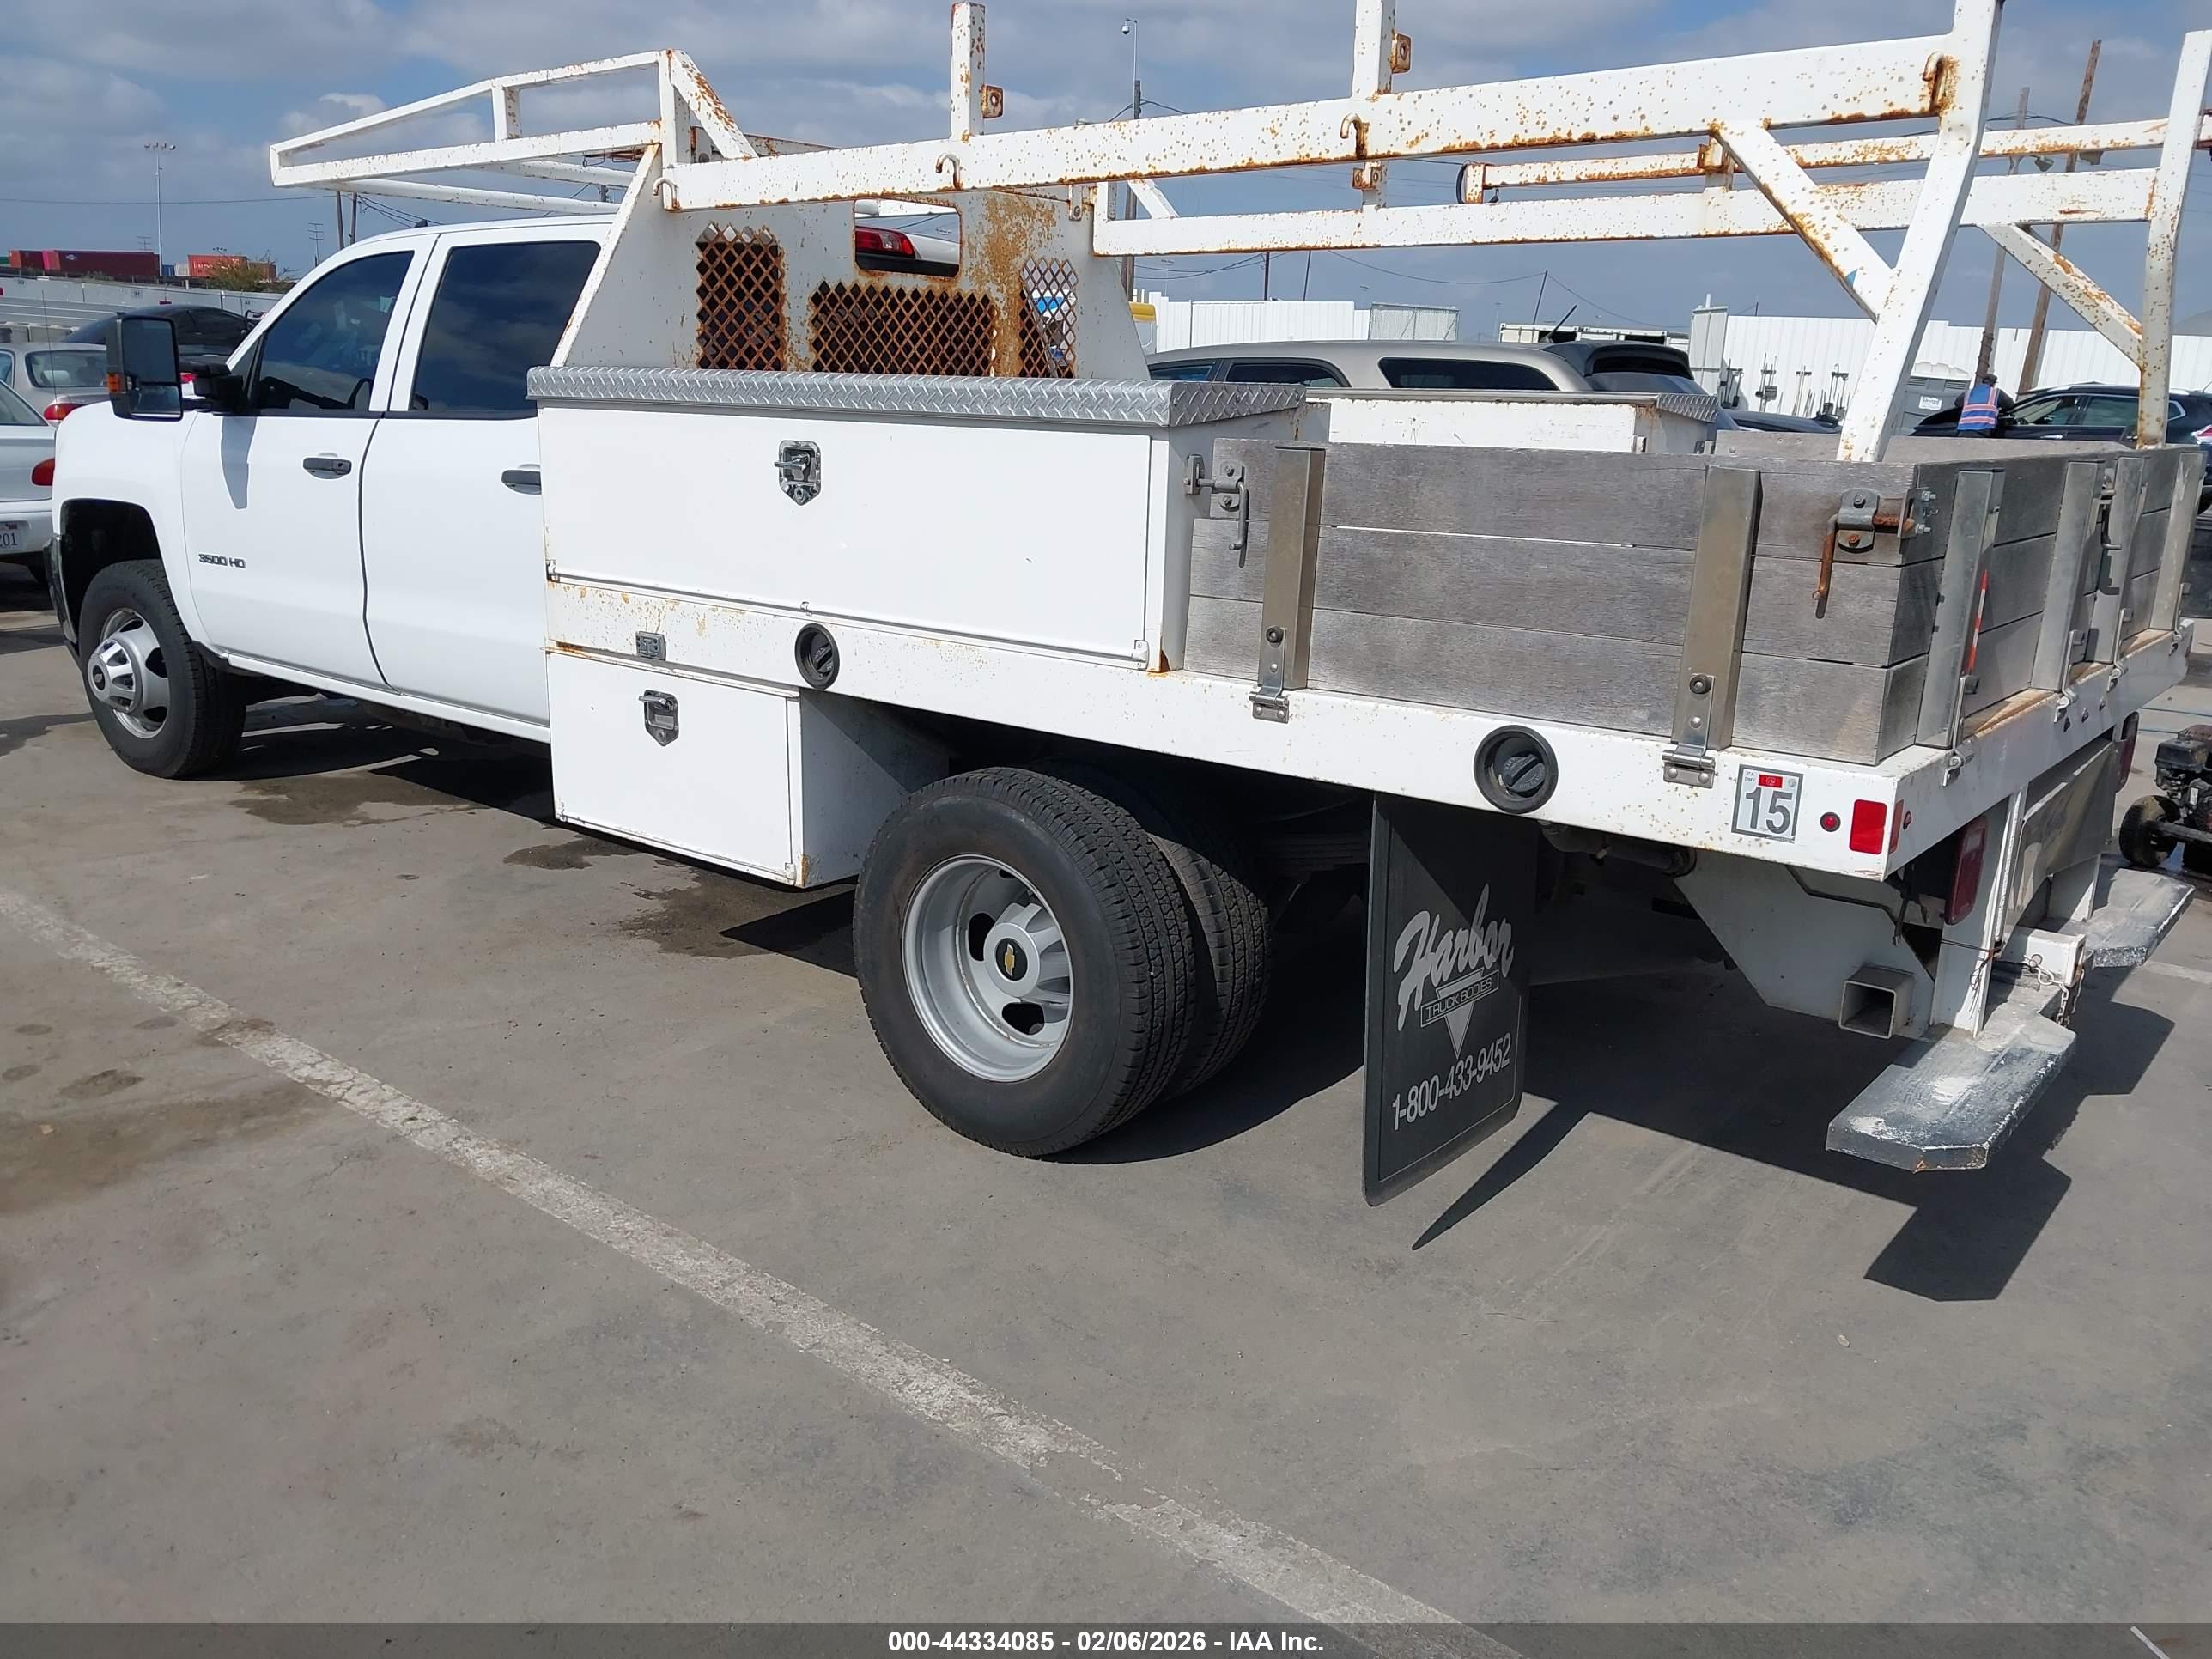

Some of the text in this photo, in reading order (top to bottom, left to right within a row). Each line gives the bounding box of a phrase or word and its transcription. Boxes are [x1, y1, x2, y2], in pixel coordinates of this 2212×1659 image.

[198, 553, 247, 569] 3500 HD
[1745, 787, 1793, 835] 15
[1393, 883, 1515, 1031] Harbor
[1425, 977, 1493, 1018] TRUCK BODIES
[1391, 1032, 1512, 1132] 1-800-433-9452
